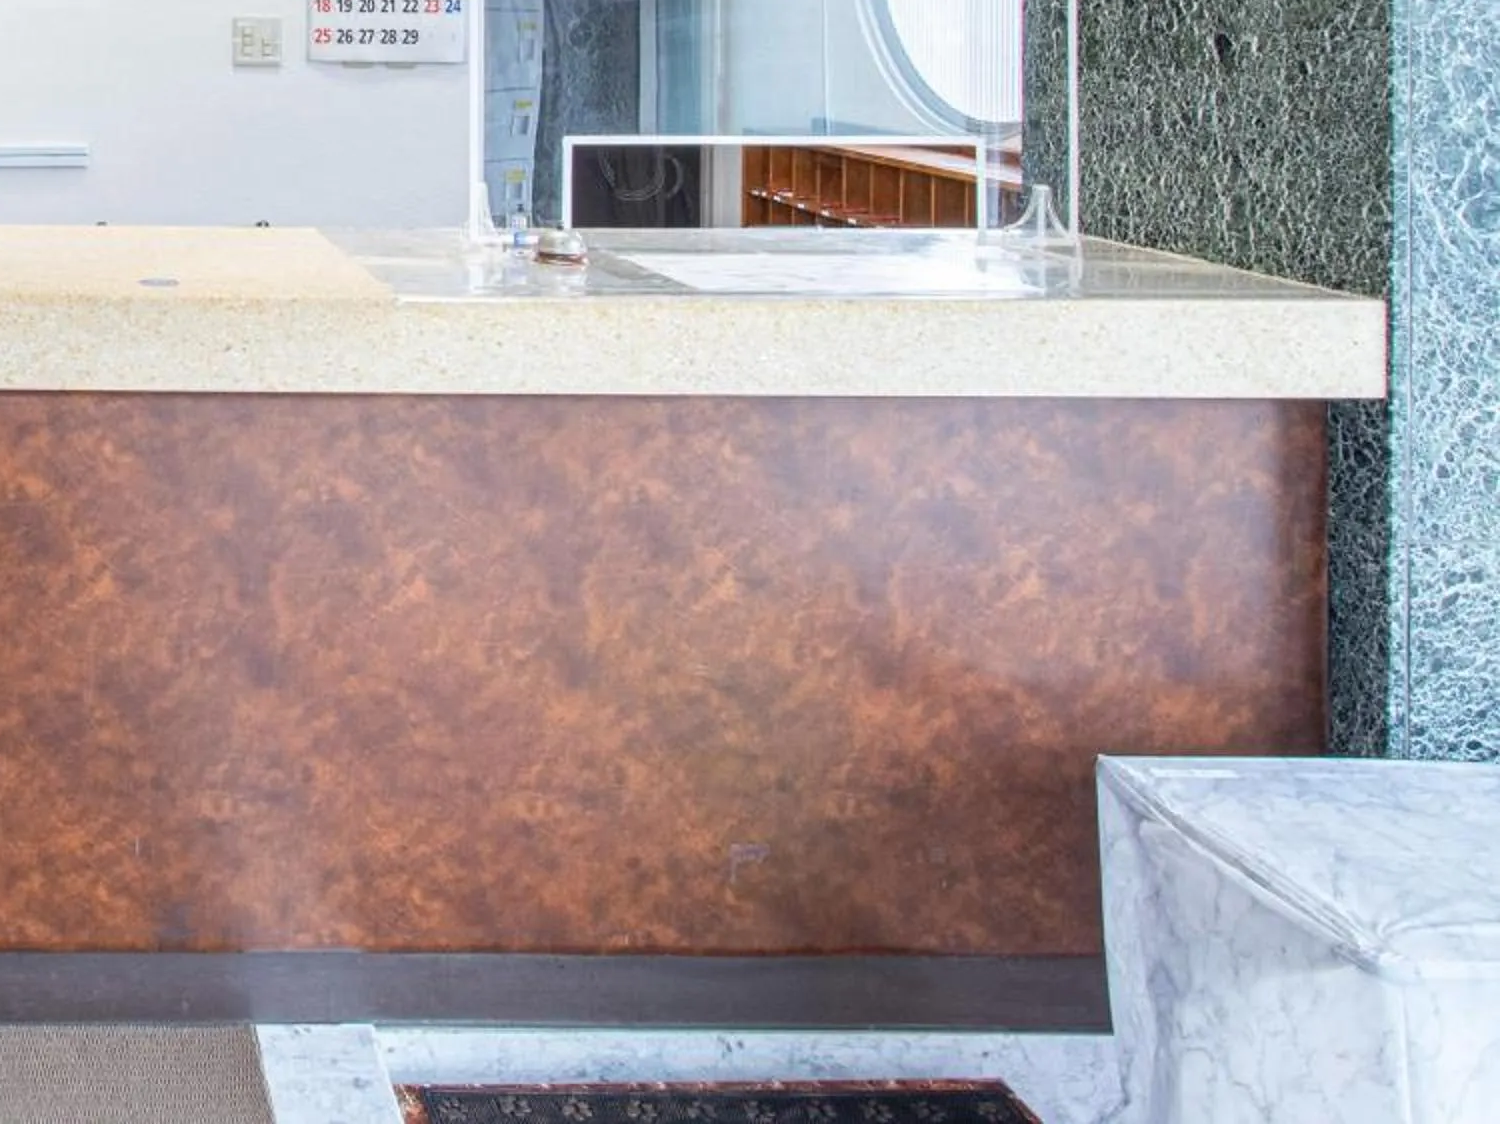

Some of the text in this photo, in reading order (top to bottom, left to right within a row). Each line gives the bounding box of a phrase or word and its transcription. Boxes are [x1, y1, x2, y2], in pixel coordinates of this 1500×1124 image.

[314, 29, 419, 45] 25 26 27 28 29
